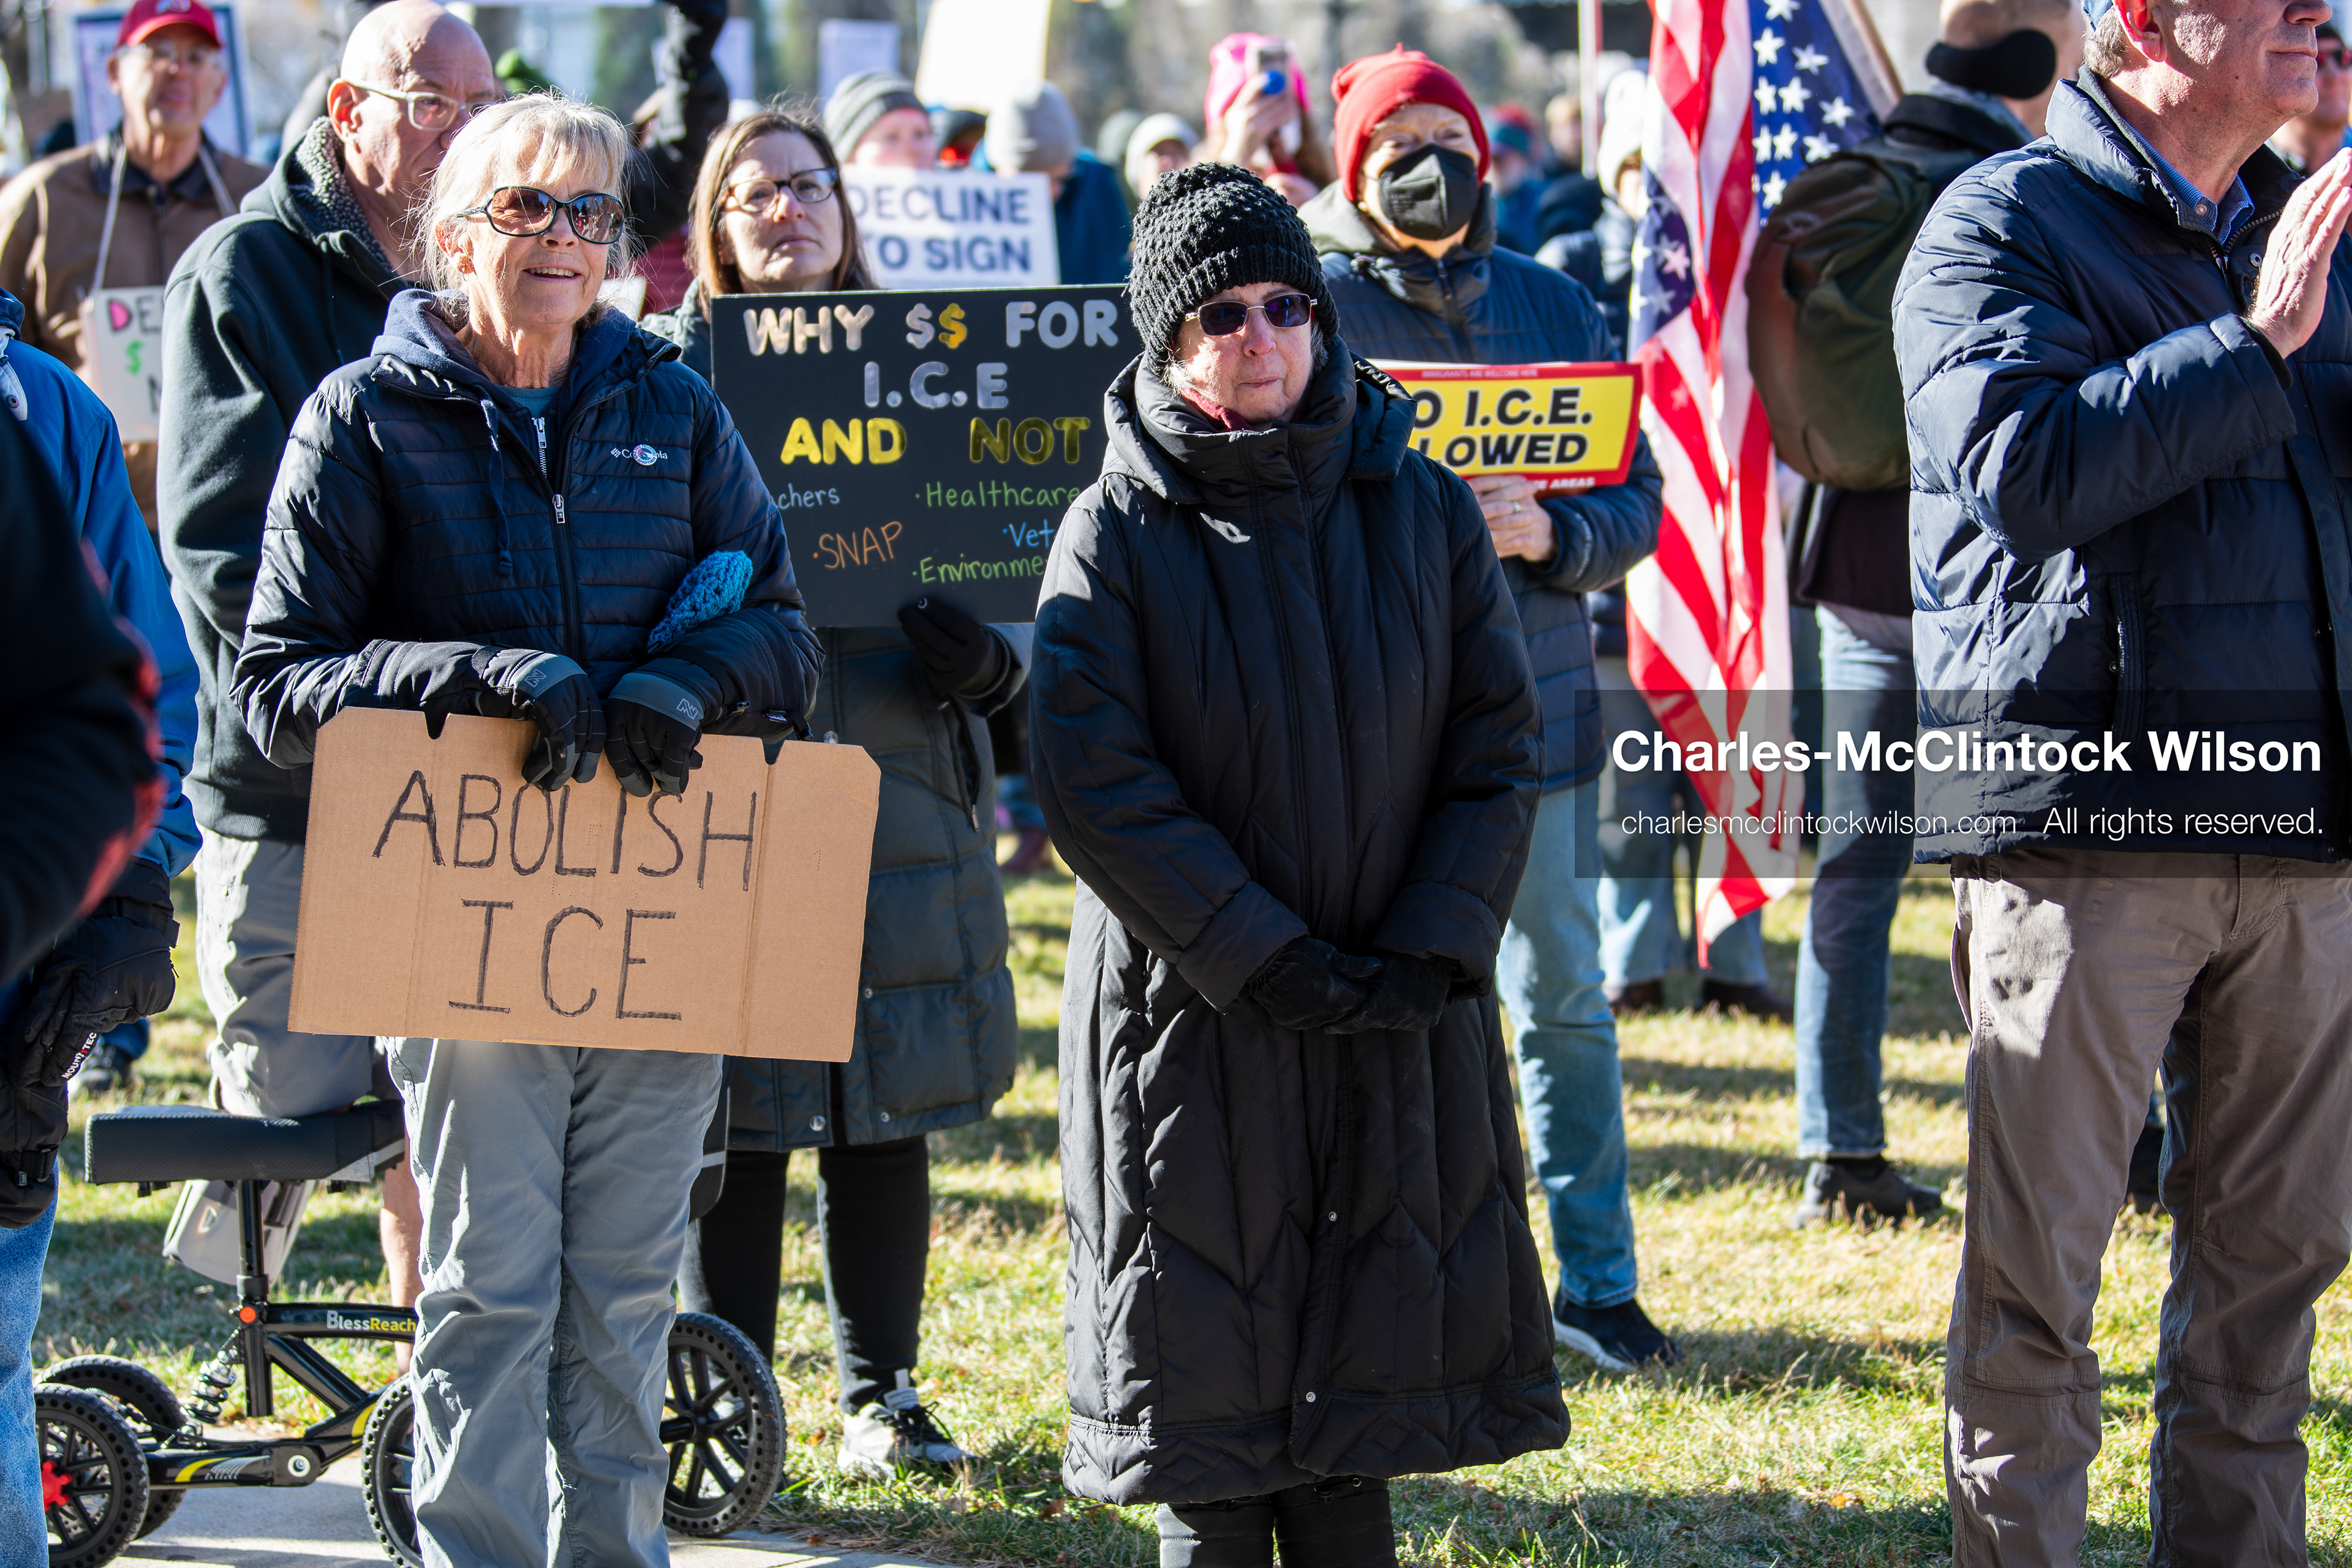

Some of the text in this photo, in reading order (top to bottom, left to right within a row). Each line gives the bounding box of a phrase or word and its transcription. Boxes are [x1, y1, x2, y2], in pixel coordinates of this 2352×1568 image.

[850, 186, 1030, 223] DECLINE
[924, 236, 1030, 272] SIGN
[108, 295, 164, 332] DE
[743, 300, 1118, 356] WHY $$ FOR
[864, 361, 1008, 409] I.C.E
[1470, 369, 1483, 377] ARE
[1485, 369, 1519, 377] WELCOME
[1464, 386, 1593, 428] I.C.E.
[781, 417, 1090, 465] AND NOT
[775, 483, 840, 510] chers
[1550, 477, 1595, 489] AREAS
[819, 521, 903, 568] SNAP
[920, 552, 1048, 583] Environme
[372, 770, 757, 892] ABOLISH
[448, 899, 682, 1020] ICE
[326, 1310, 417, 1332] BlessReach
